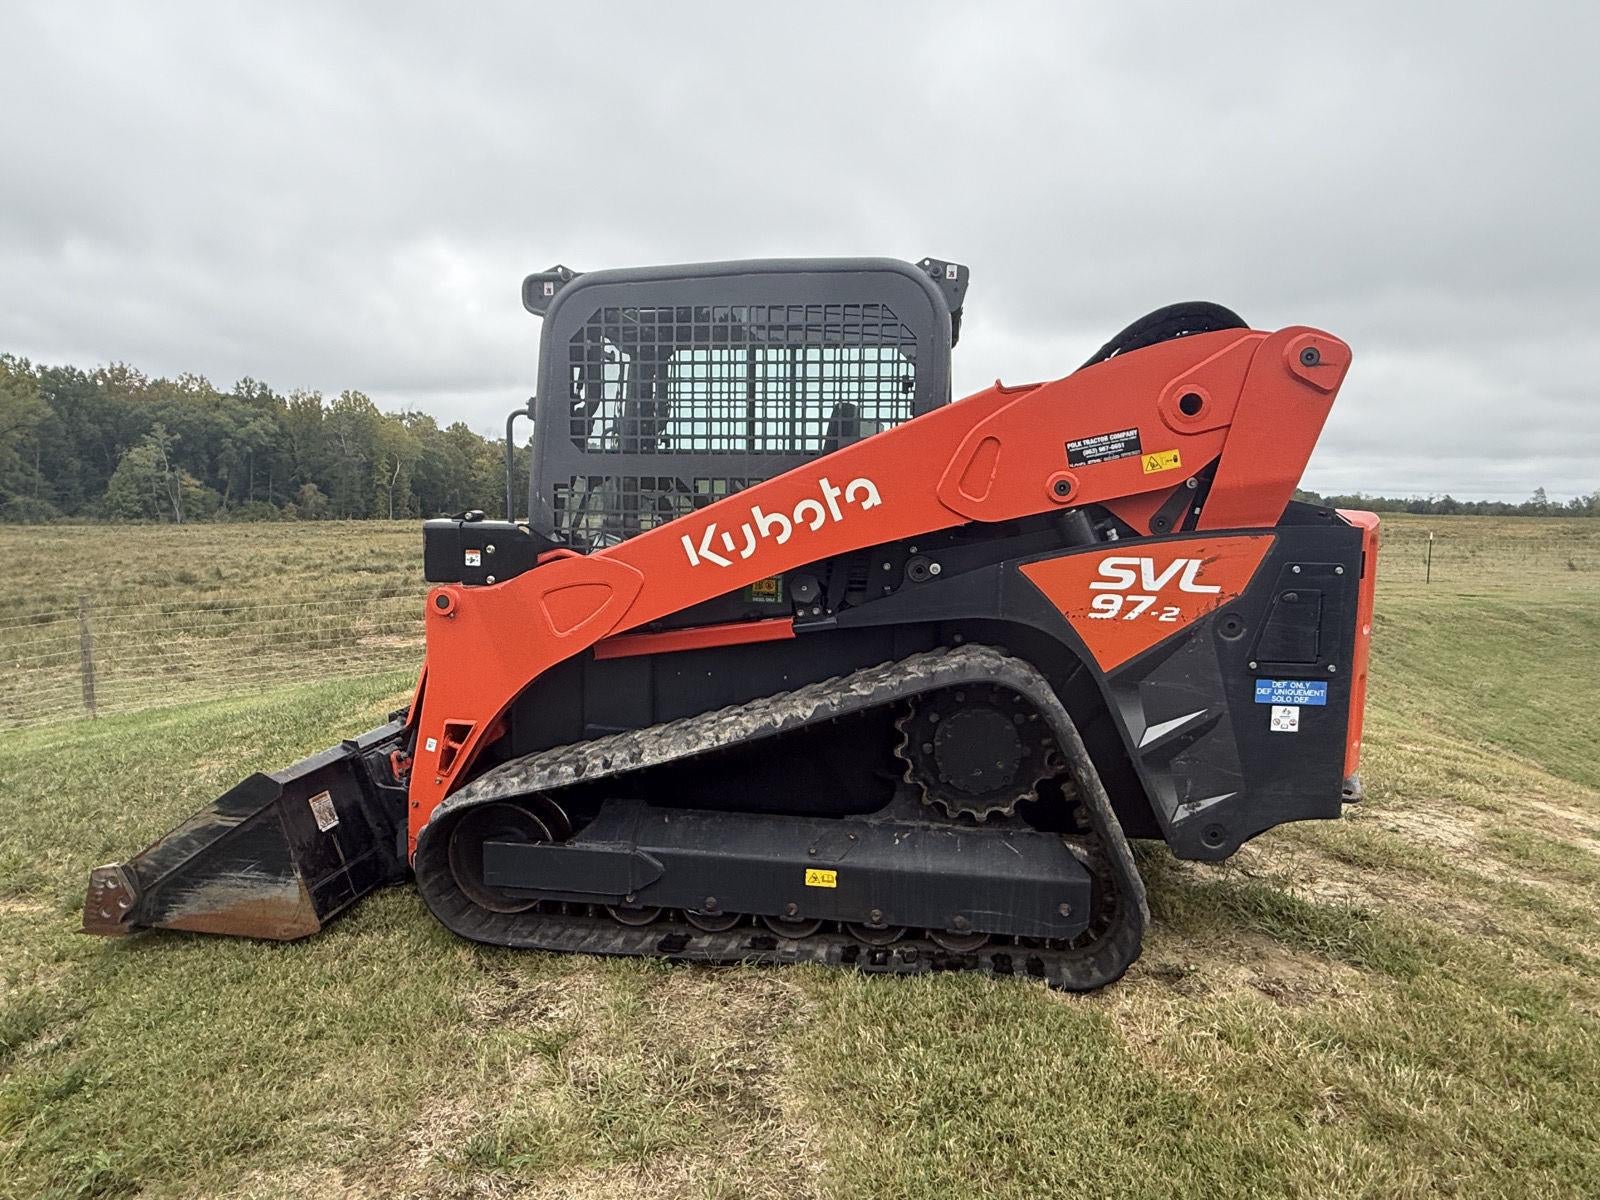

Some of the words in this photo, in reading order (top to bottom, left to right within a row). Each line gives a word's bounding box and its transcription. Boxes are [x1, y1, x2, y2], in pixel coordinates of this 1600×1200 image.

[1083, 435, 1109, 446] TRACTOR
[1109, 429, 1138, 441] COMPANY
[681, 477, 882, 568] Kubota
[1089, 556, 1222, 593] SVL
[1088, 593, 1181, 622] 97-2
[1256, 687, 1273, 695] DEF
[1273, 688, 1325, 697] UNIQUEMENT
[1272, 681, 1288, 689] DEF
[1289, 681, 1311, 689] ONLY
[1271, 695, 1292, 703] SOLO
